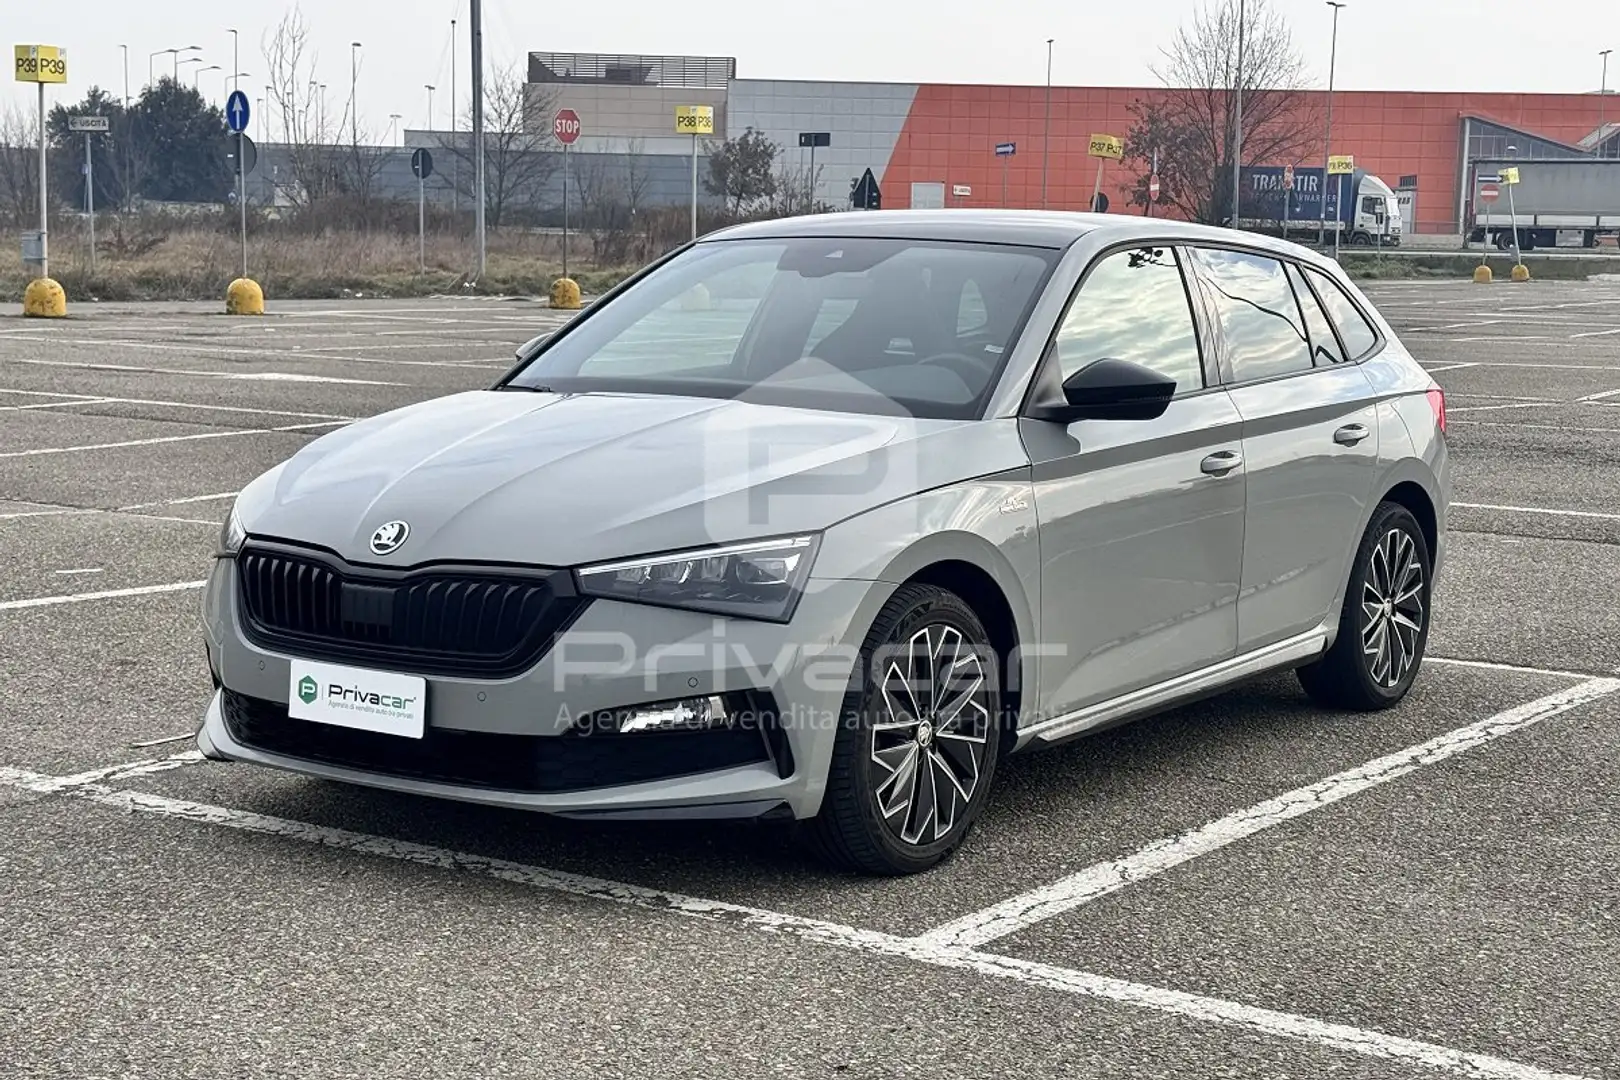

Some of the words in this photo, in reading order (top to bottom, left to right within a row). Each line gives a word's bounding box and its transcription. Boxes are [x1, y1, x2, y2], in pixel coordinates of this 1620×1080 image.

[16, 57, 37, 73] P39
[40, 57, 65, 75] P39
[556, 118, 579, 134] STOP
[677, 115, 697, 128] P38
[1091, 141, 1105, 152] P37
[1252, 174, 1318, 192] TRANTIR
[328, 684, 415, 710] Privacar
